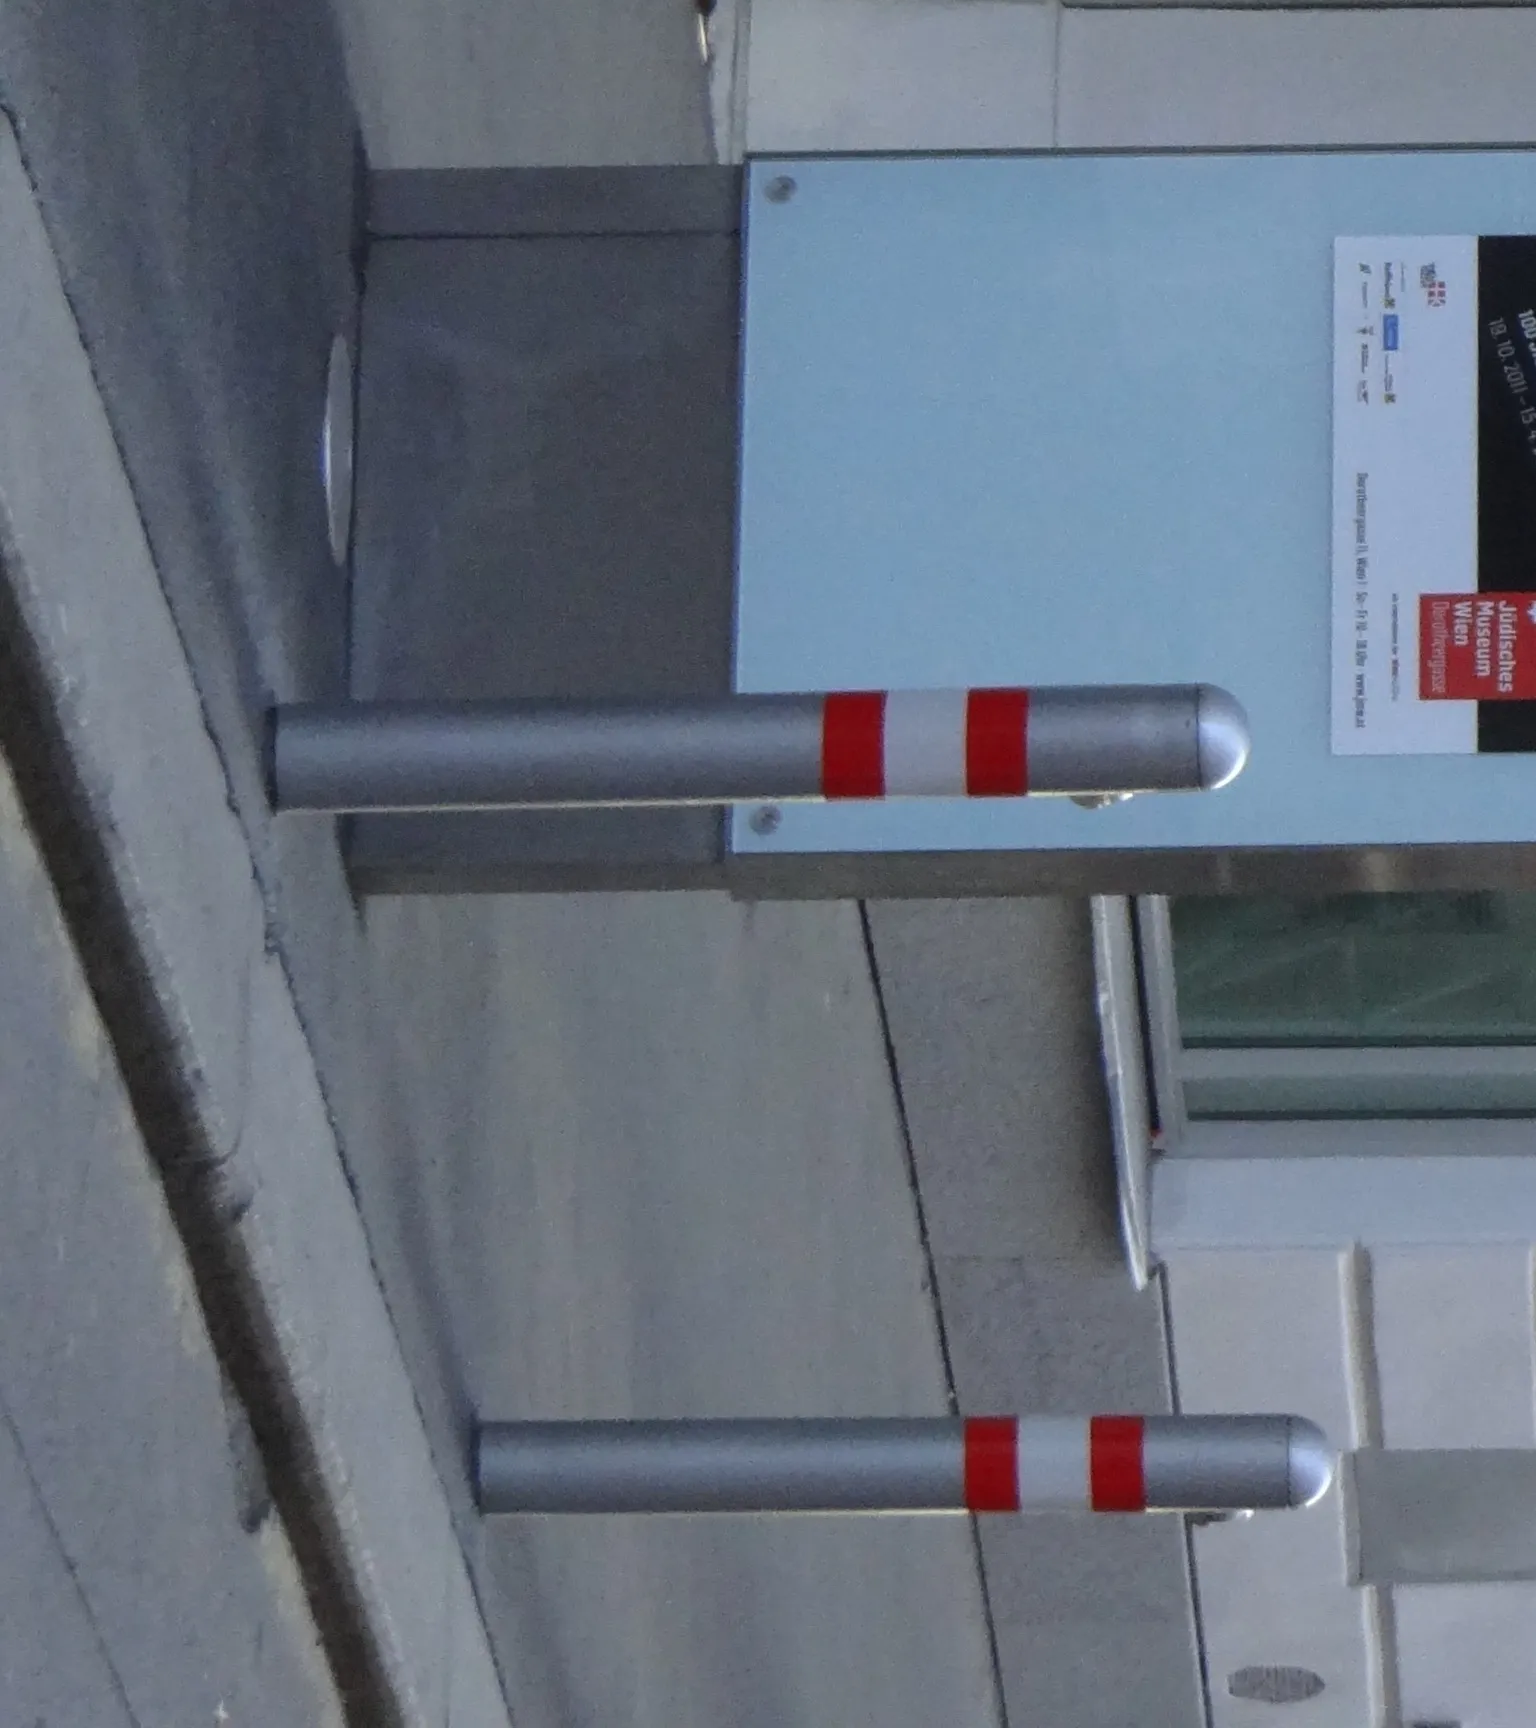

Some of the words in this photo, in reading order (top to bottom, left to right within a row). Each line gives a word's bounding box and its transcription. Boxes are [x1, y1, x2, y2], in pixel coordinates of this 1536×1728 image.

[1503, 361, 1529, 394] 2011
[1453, 600, 1473, 646] Wien
[1476, 600, 1495, 677] Museum
[1497, 600, 1518, 693] Jüdisches
